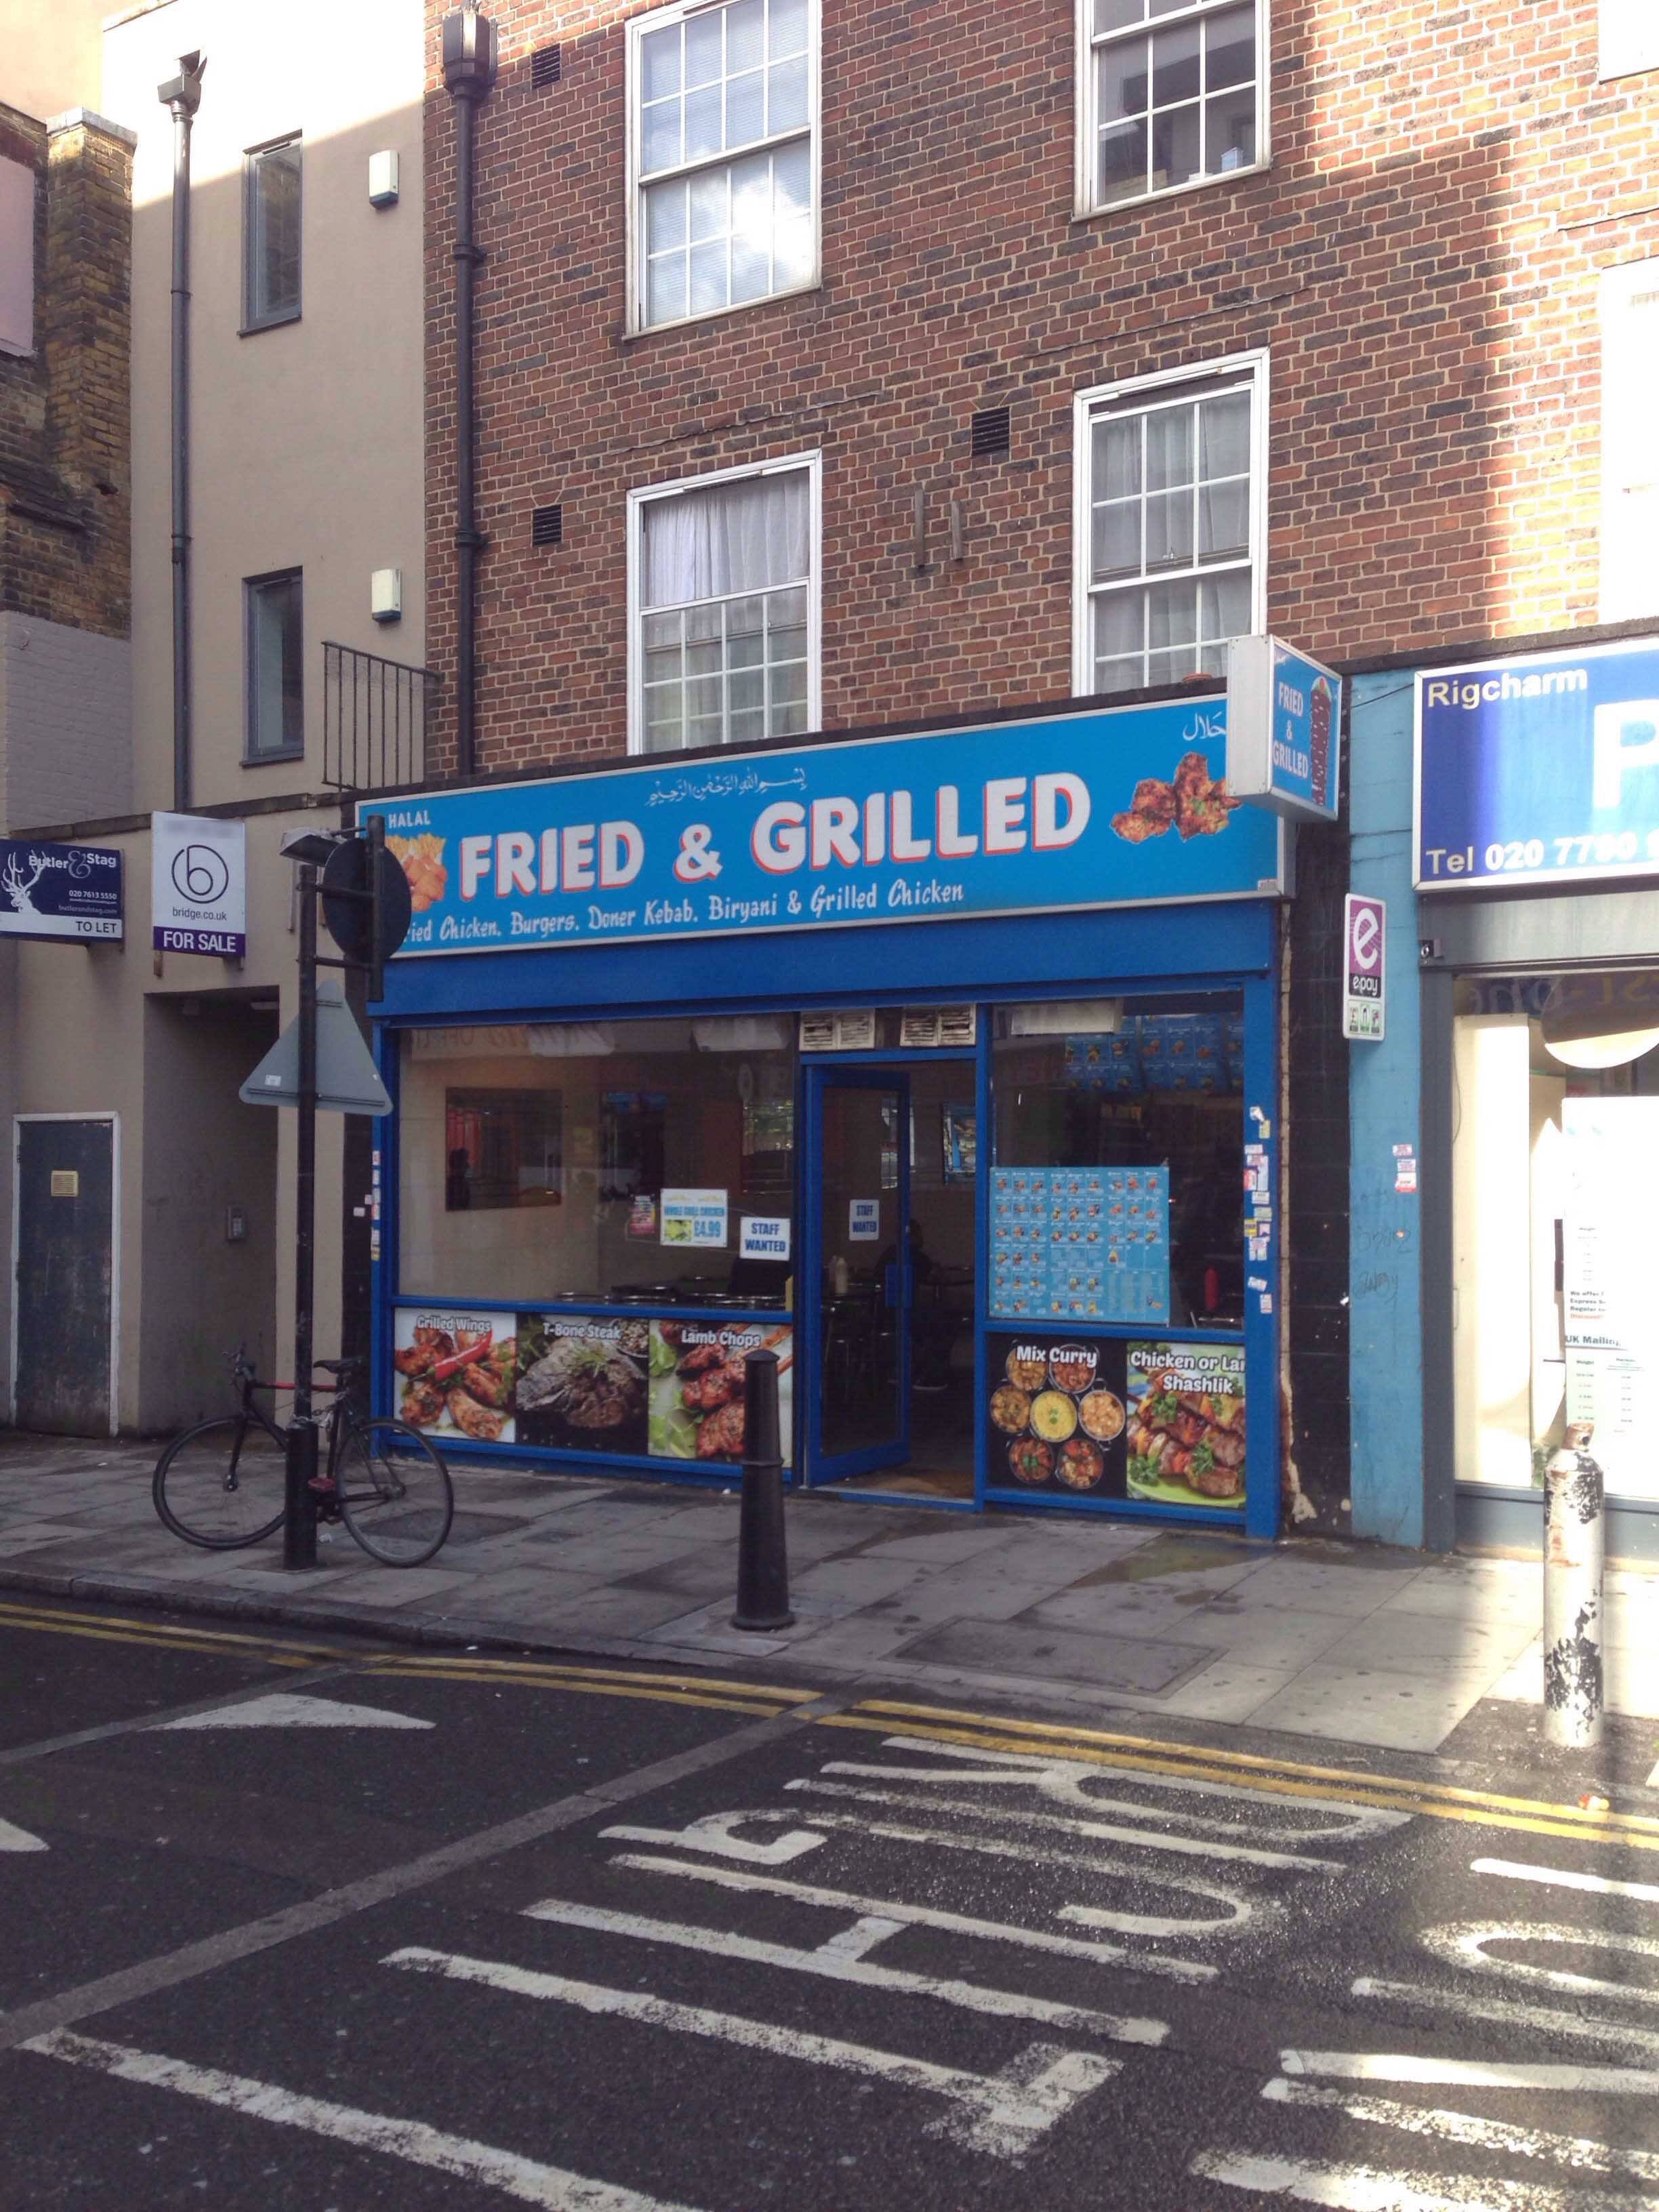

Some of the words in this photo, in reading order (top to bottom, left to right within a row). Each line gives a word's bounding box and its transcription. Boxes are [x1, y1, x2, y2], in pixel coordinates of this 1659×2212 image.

[1428, 666, 1588, 710] Rigcharm
[1278, 681, 1303, 717] FRIED
[1286, 719, 1293, 741] &
[1273, 740, 1309, 779] GRILLED
[388, 810, 430, 828] HALAL
[460, 821, 644, 901] FRIED
[673, 823, 722, 882] &
[750, 772, 1090, 874] GRILLED
[28, 855, 68, 869] Butler
[68, 850, 91, 878] &
[87, 853, 117, 868] Stag
[1427, 847, 1474, 874] Tel
[1485, 838, 1544, 871] 020
[68, 889, 82, 897] 020
[100, 892, 117, 900] 5550
[589, 904, 636, 928] Doner
[708, 893, 777, 922] Biryani
[787, 890, 802, 915] &
[810, 883, 877, 918] Grilled
[888, 878, 964, 907] Chicken
[172, 907, 227, 921] bridge.co.uk
[76, 920, 92, 933] TO
[96, 922, 117, 934] LET
[163, 930, 194, 949] FOR
[198, 933, 237, 953] SALE
[751, 1223, 781, 1236] STAFF
[852, 1221, 878, 1233] WANTED
[745, 1240, 786, 1254] WANTED
[417, 1315, 455, 1331] Grilled
[455, 1317, 492, 1334] Wings
[544, 1322, 586, 1338] T-Bone
[587, 1324, 621, 1340] Steak
[682, 1330, 715, 1346] Lamb
[718, 1331, 760, 1349] Chops
[1565, 1335, 1579, 1344] UK
[1017, 1345, 1046, 1363] Mix
[1049, 1347, 1098, 1368] Curry
[1130, 1351, 1194, 1370] Chicken
[1198, 1357, 1218, 1370] or
[1163, 1374, 1233, 1395] Shashlik
